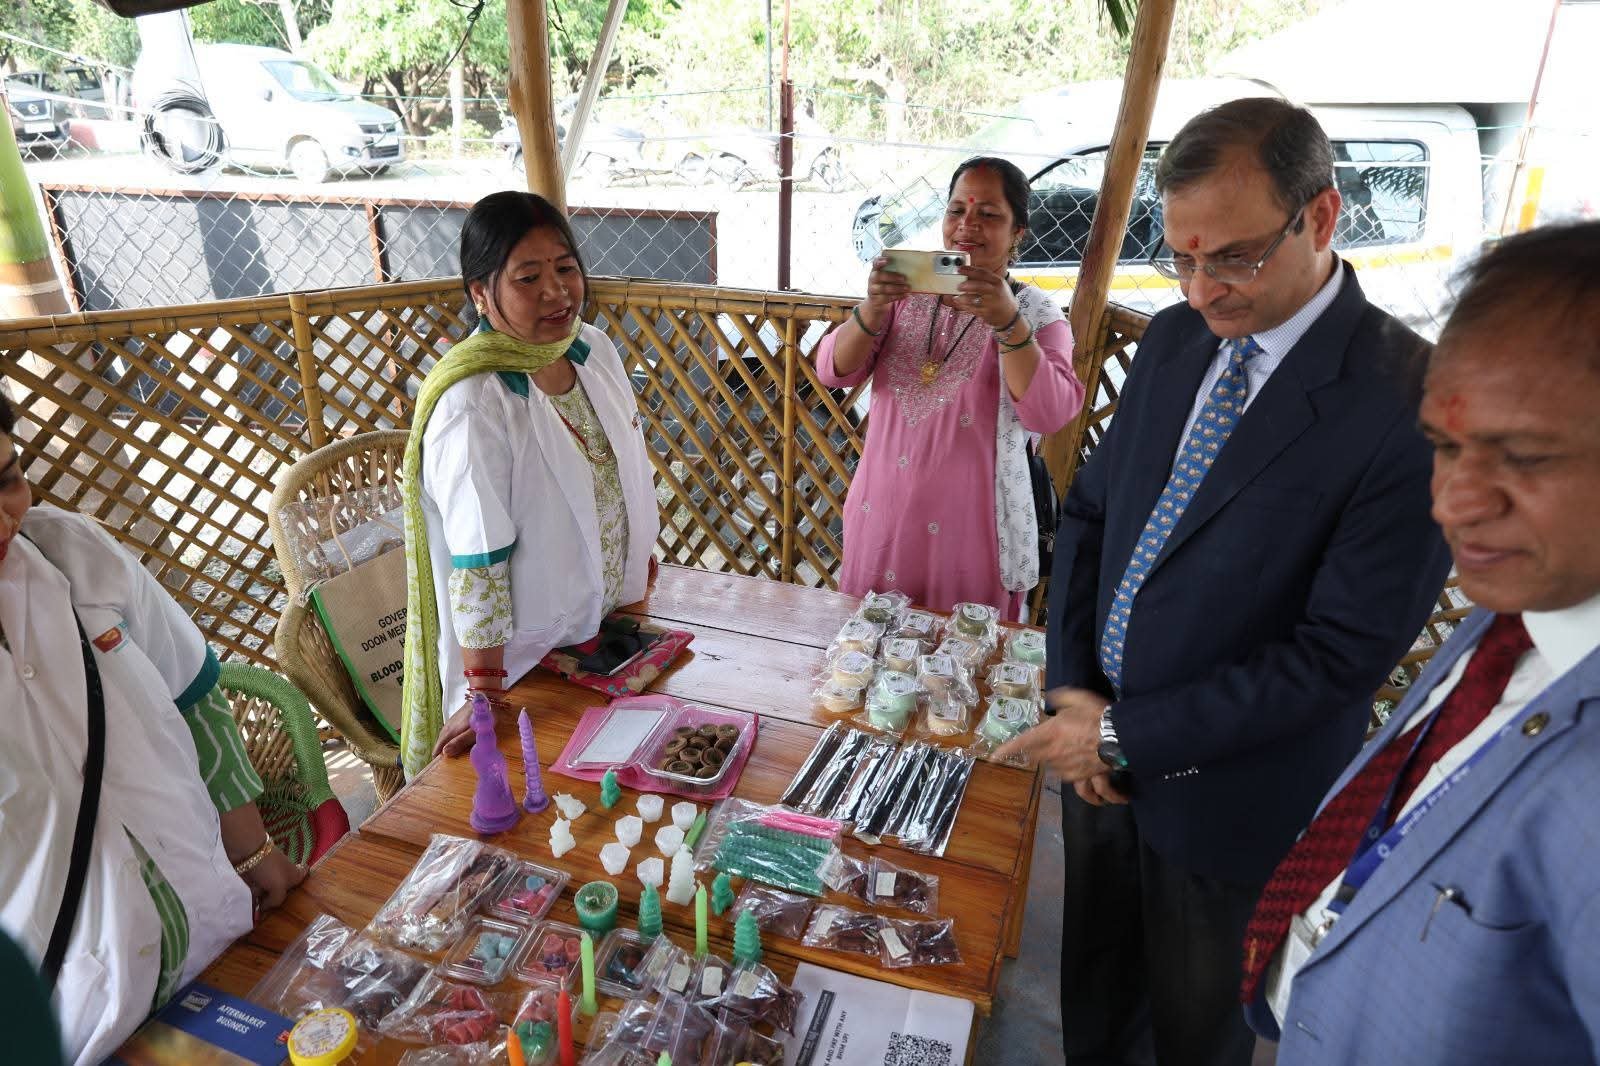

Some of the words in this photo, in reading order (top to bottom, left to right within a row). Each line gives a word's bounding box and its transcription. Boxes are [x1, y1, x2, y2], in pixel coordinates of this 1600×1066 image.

[361, 633, 387, 652] DOON
[370, 661, 403, 683] BLOOD
[216, 1015, 250, 1034] BUSINESS
[218, 1004, 267, 1028] AFTERMARKET
[825, 1049, 835, 1062] AND
[834, 1023, 843, 1037] WITH
[840, 1010, 848, 1022] ANY
